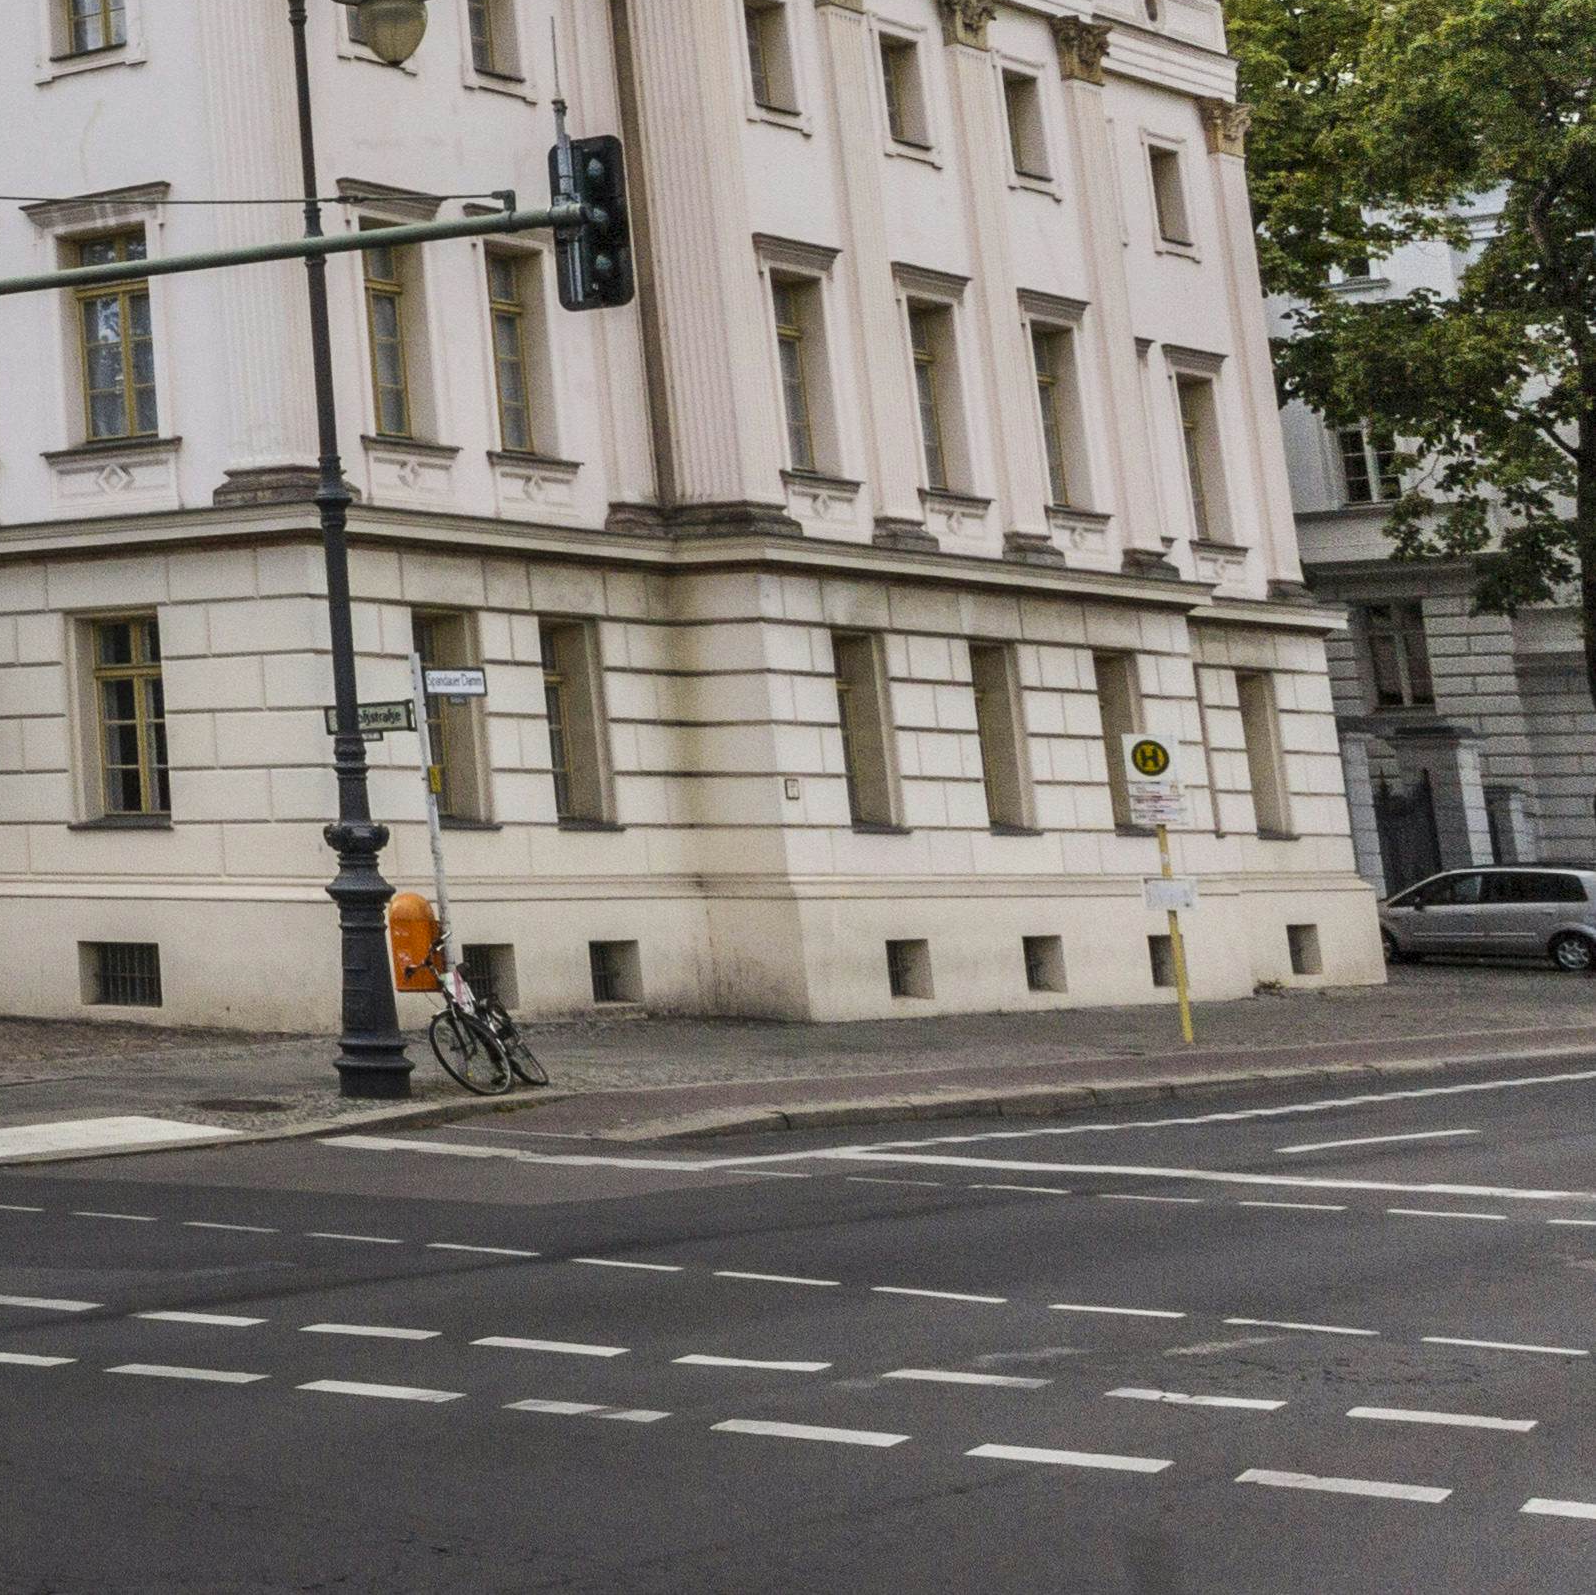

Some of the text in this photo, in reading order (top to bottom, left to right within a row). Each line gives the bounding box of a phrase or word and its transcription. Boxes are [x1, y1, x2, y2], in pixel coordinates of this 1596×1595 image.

[427, 672, 483, 689] Spandauer Damm
[1141, 748, 1160, 767] H
